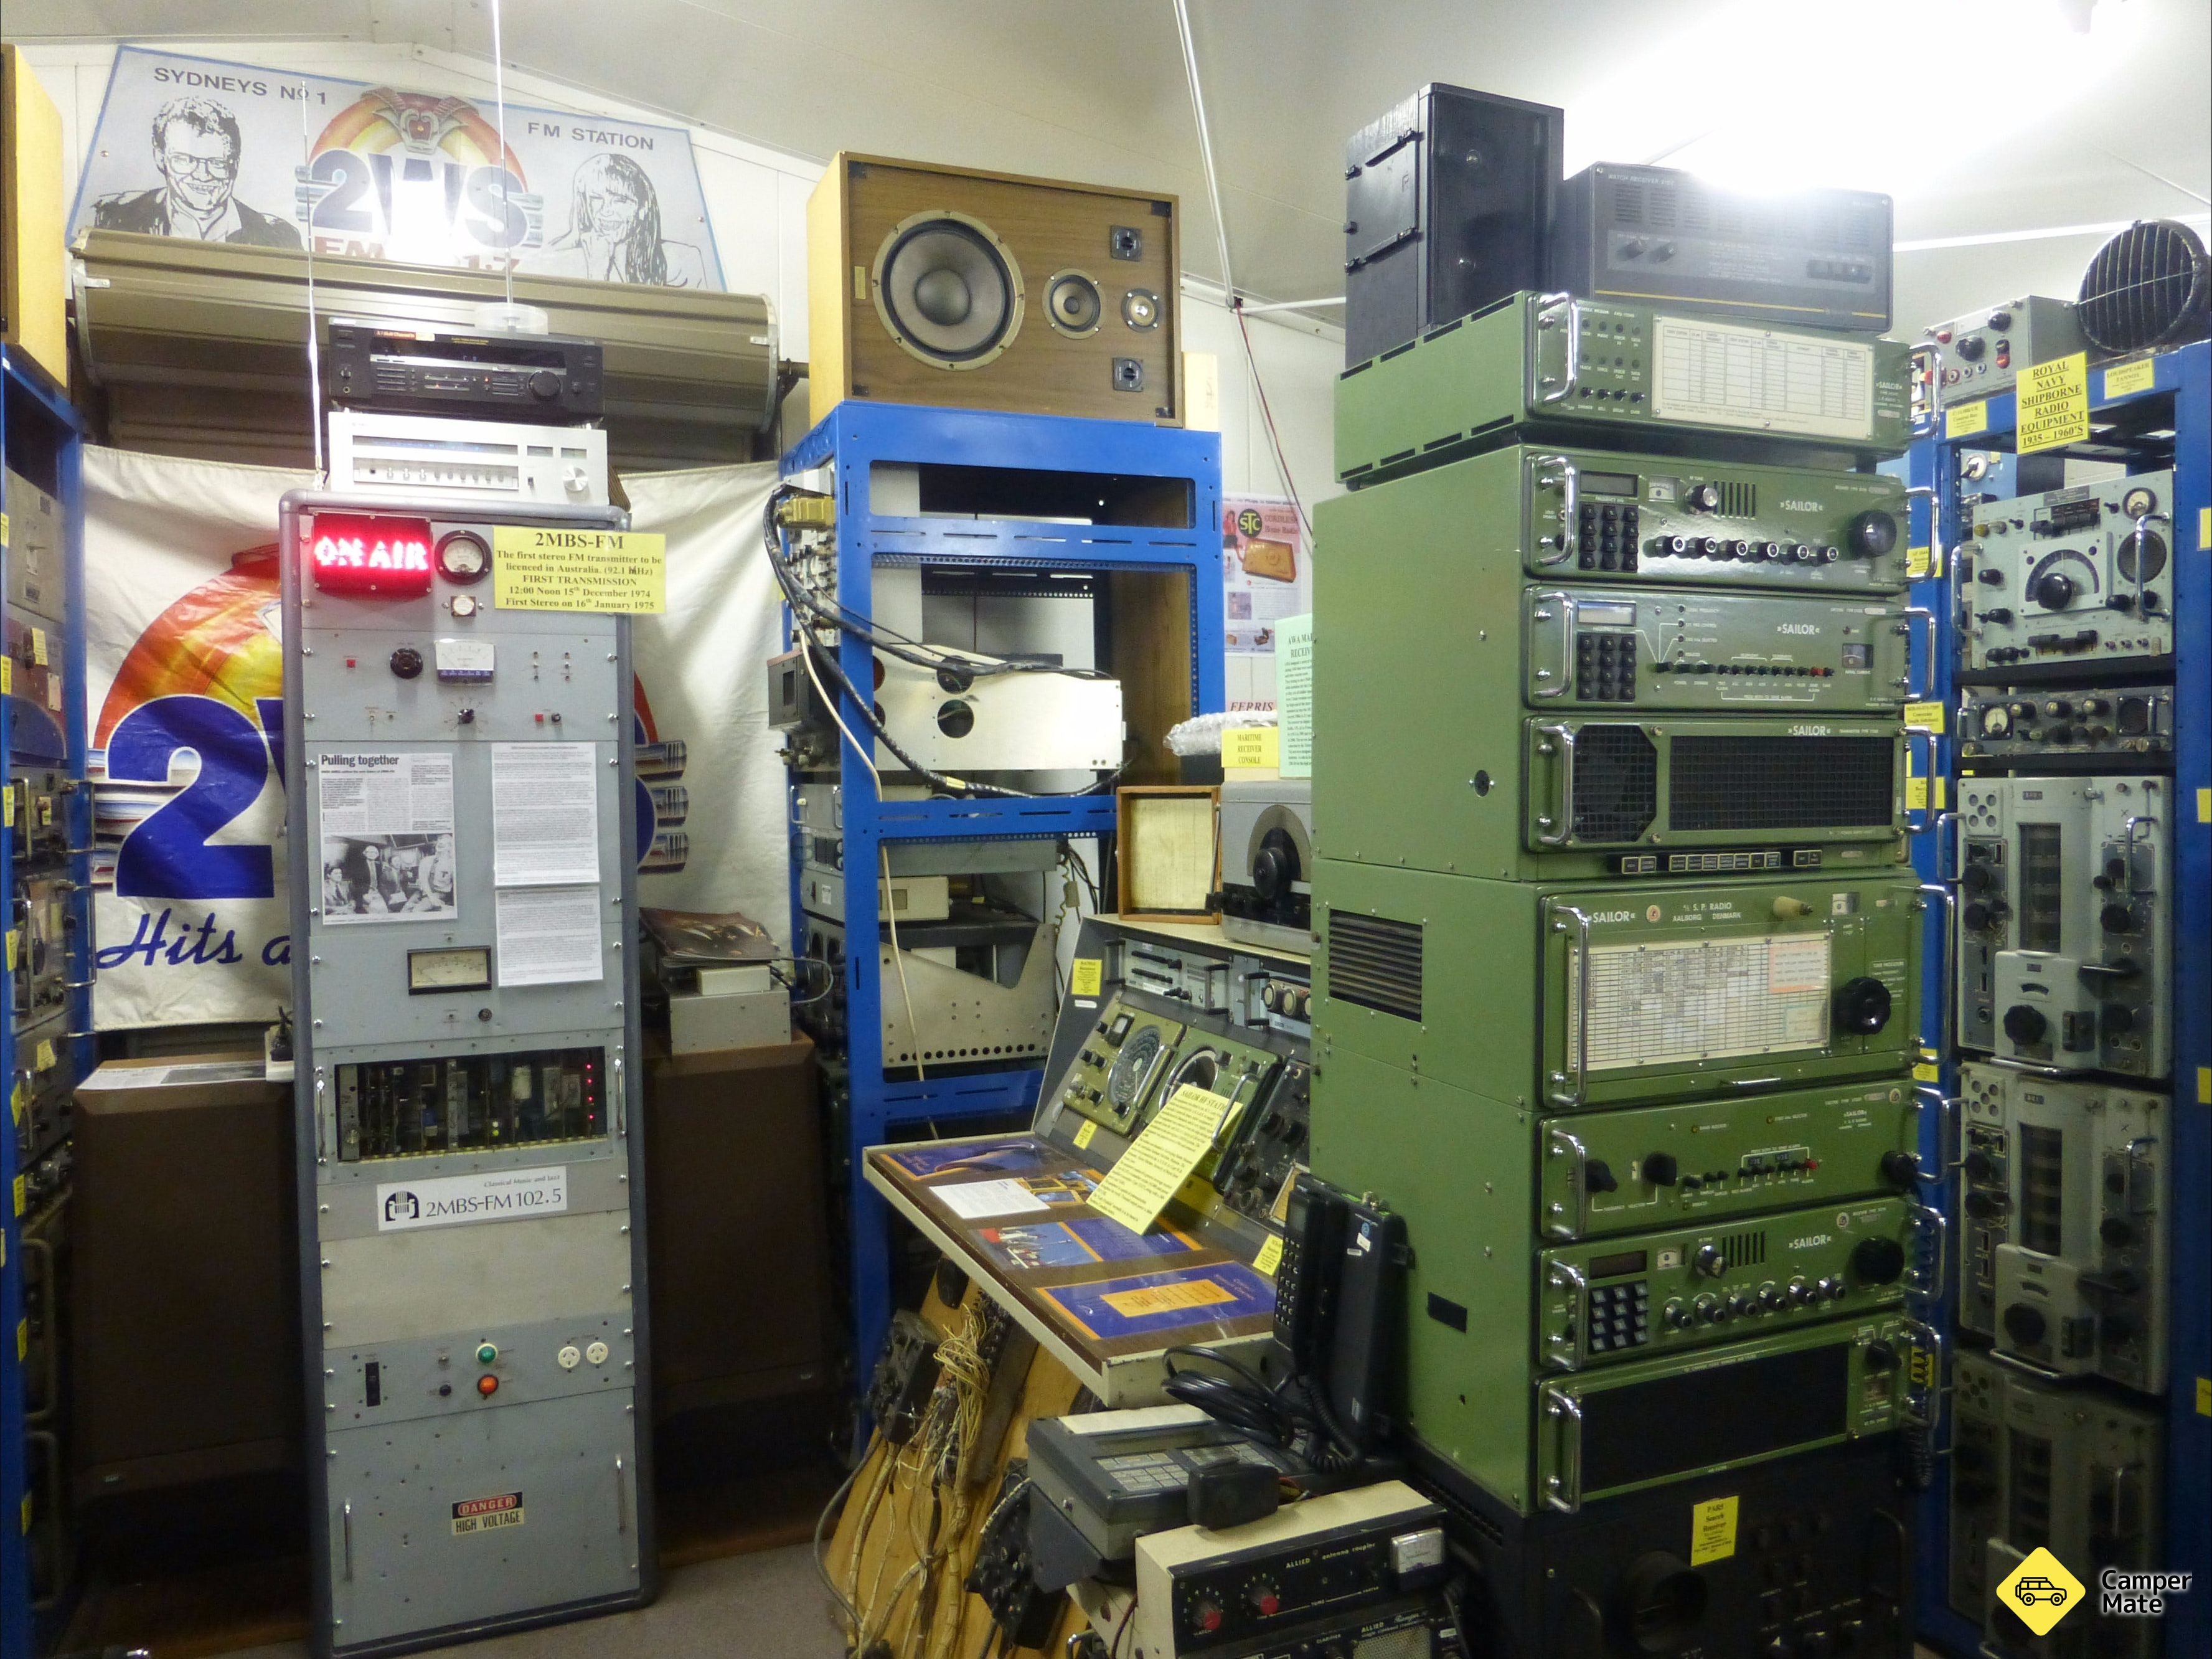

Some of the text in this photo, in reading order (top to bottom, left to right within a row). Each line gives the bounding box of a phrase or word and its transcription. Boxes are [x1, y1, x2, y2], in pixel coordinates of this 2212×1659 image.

[154, 67, 267, 97] SYDNEYS
[316, 92, 327, 105] 1
[528, 122, 654, 151] FM STATION
[2033, 361, 2069, 378] ROYAL
[2036, 375, 2066, 390] NAVY
[2021, 384, 2082, 406] SHIPBORNE
[2035, 401, 2069, 417] RADIO
[2021, 410, 2084, 434] EQUIPMENT
[2023, 433, 2043, 447] 1935
[1240, 513, 1261, 534] STC
[535, 532, 624, 549] 2MBS-FM
[314, 536, 429, 570] ON AIR
[497, 550, 514, 559] The
[517, 551, 535, 559] first
[539, 552, 565, 561] stereo
[588, 554, 638, 564] transmitter
[652, 556, 662, 564] be
[506, 562, 542, 572] licenced
[523, 575, 637, 586] FIRST TRANSMISSION
[510, 586, 534, 594] 12:00
[537, 587, 560, 595] Noon
[583, 588, 627, 598] December
[506, 598, 527, 606] First
[530, 598, 559, 607] Stereo
[595, 601, 631, 611] January
[1237, 734, 1262, 742] MARITIME
[1237, 745, 1262, 753] RECEIVER
[321, 754, 400, 768] Pulling together
[1238, 756, 1261, 764] CONSOLE
[1710, 902, 1732, 910] RADIO
[1672, 911, 1742, 922] AALBORG DENMARK
[96, 908, 243, 969] Hits
[426, 1188, 562, 1217] 2MBS-FM 102.5
[461, 1497, 513, 1514] DANGER
[456, 1511, 520, 1533] HIGH VOLTAGE
[1286, 1557, 1311, 1569] ALLIED
[1361, 1621, 1384, 1633] ALLIED
